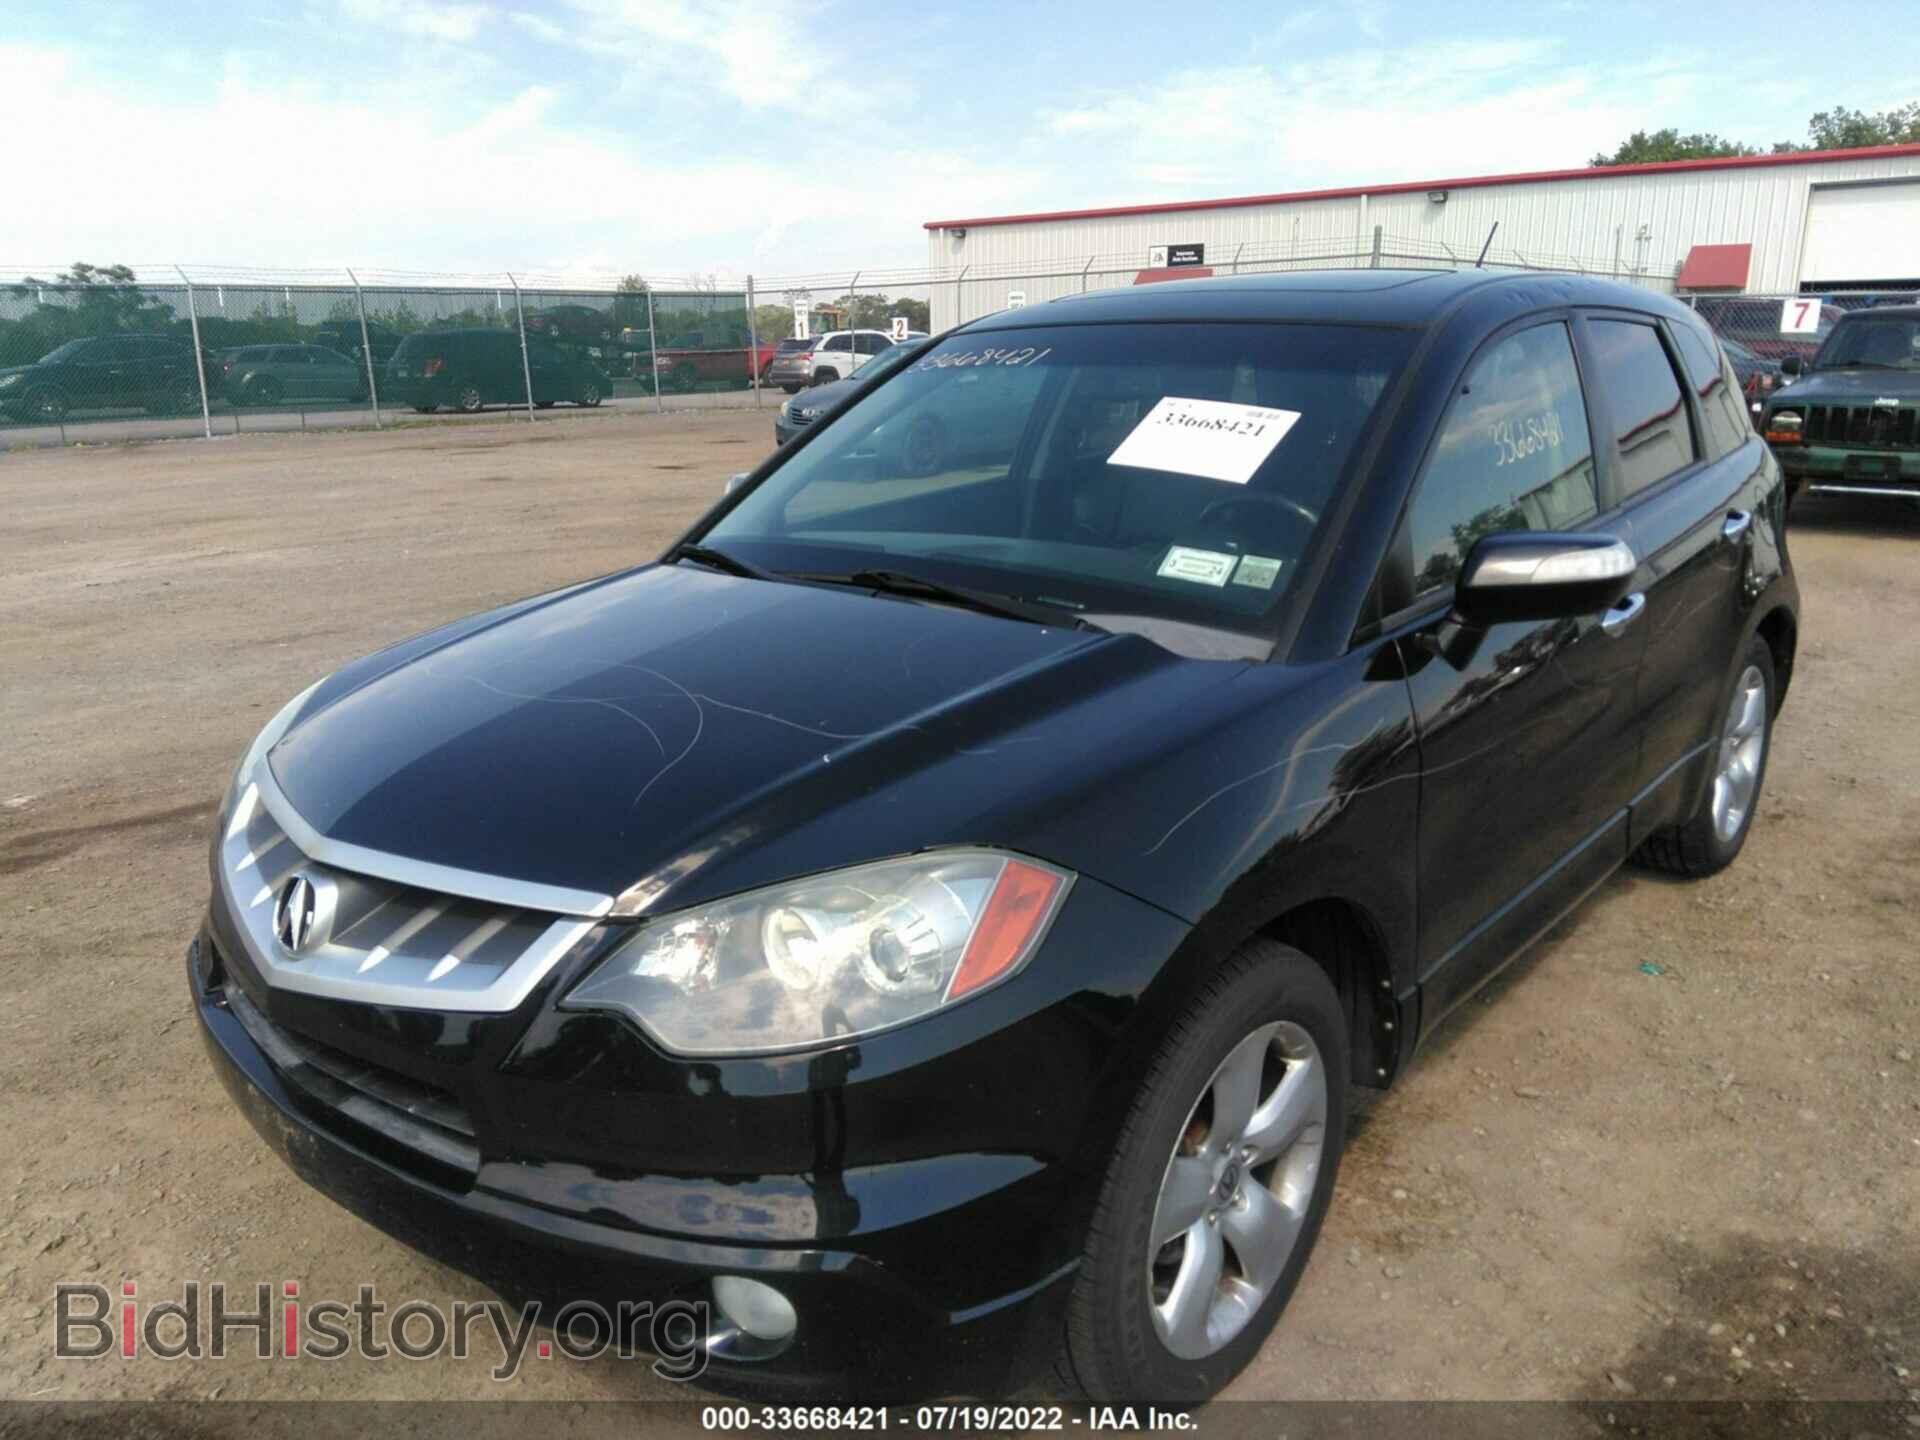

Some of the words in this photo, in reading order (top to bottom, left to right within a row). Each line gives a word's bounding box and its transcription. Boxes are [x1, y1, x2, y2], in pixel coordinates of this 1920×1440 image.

[1795, 303, 1810, 328] 7
[896, 320, 904, 337] 2
[906, 348, 1052, 374] 3668421
[1158, 412, 1266, 437] 33668421
